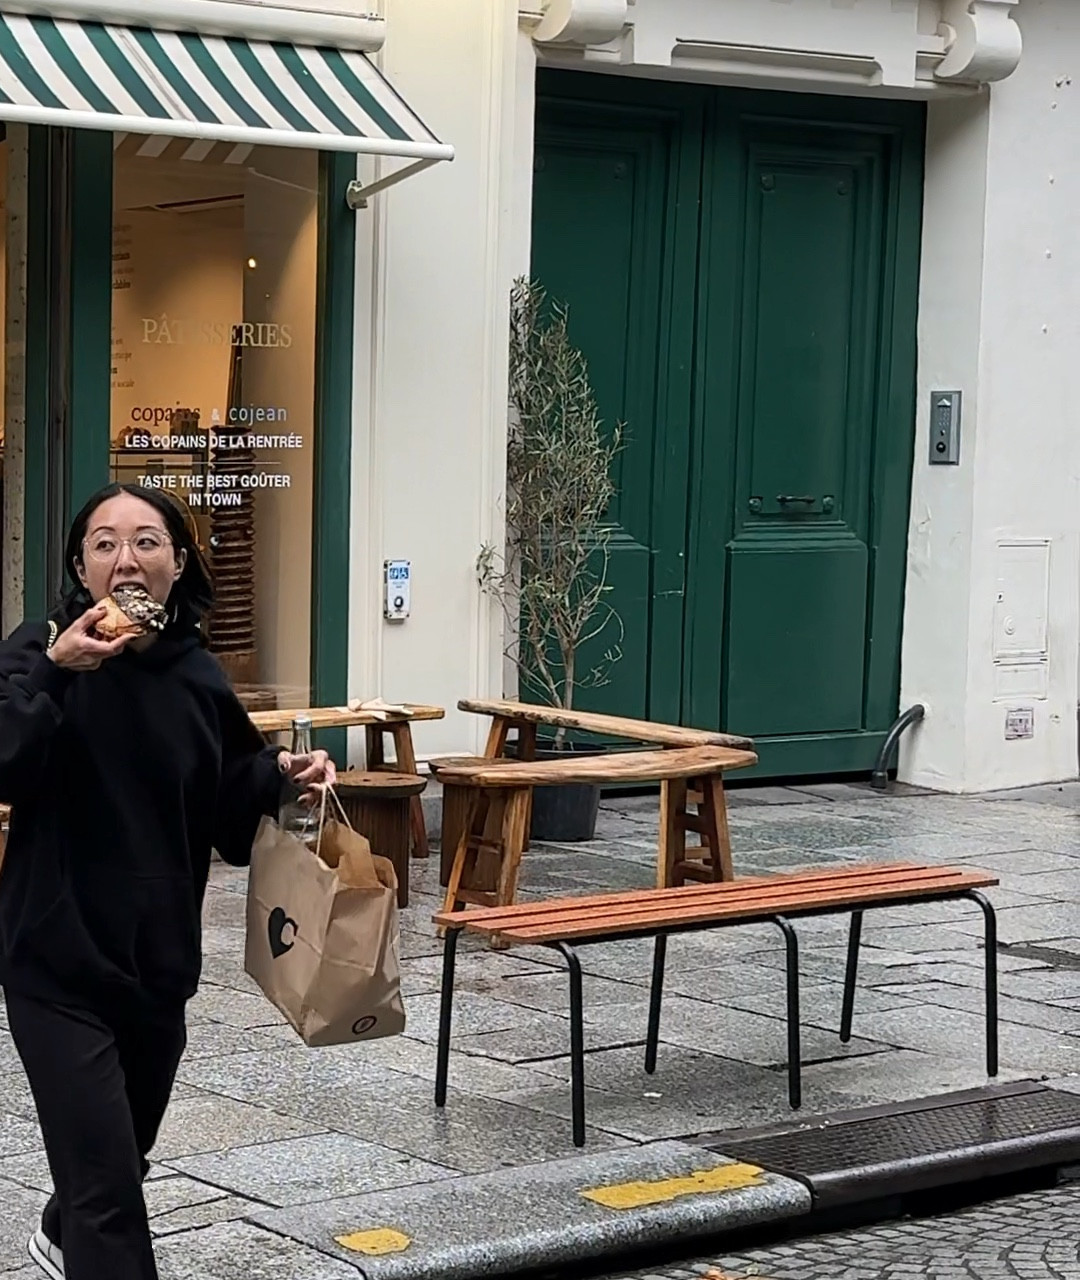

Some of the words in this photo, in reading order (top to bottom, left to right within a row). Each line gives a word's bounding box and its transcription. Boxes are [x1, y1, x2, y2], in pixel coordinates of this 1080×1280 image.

[141, 312, 292, 348] PÂTSSERIES
[131, 400, 201, 427] copains
[211, 408, 220, 421] &
[229, 403, 287, 427] cojean
[125, 434, 150, 449] LES
[151, 434, 207, 449] COPAINS
[209, 434, 228, 449] DE
[229, 434, 245, 449] LA
[247, 432, 303, 449] RENTRÉE
[137, 475, 177, 488] TASTE
[179, 475, 204, 488] THE
[207, 475, 238, 488] BEST
[241, 472, 291, 488] GOÛTER
[189, 493, 203, 507] IN
[204, 493, 242, 507] TOWN
